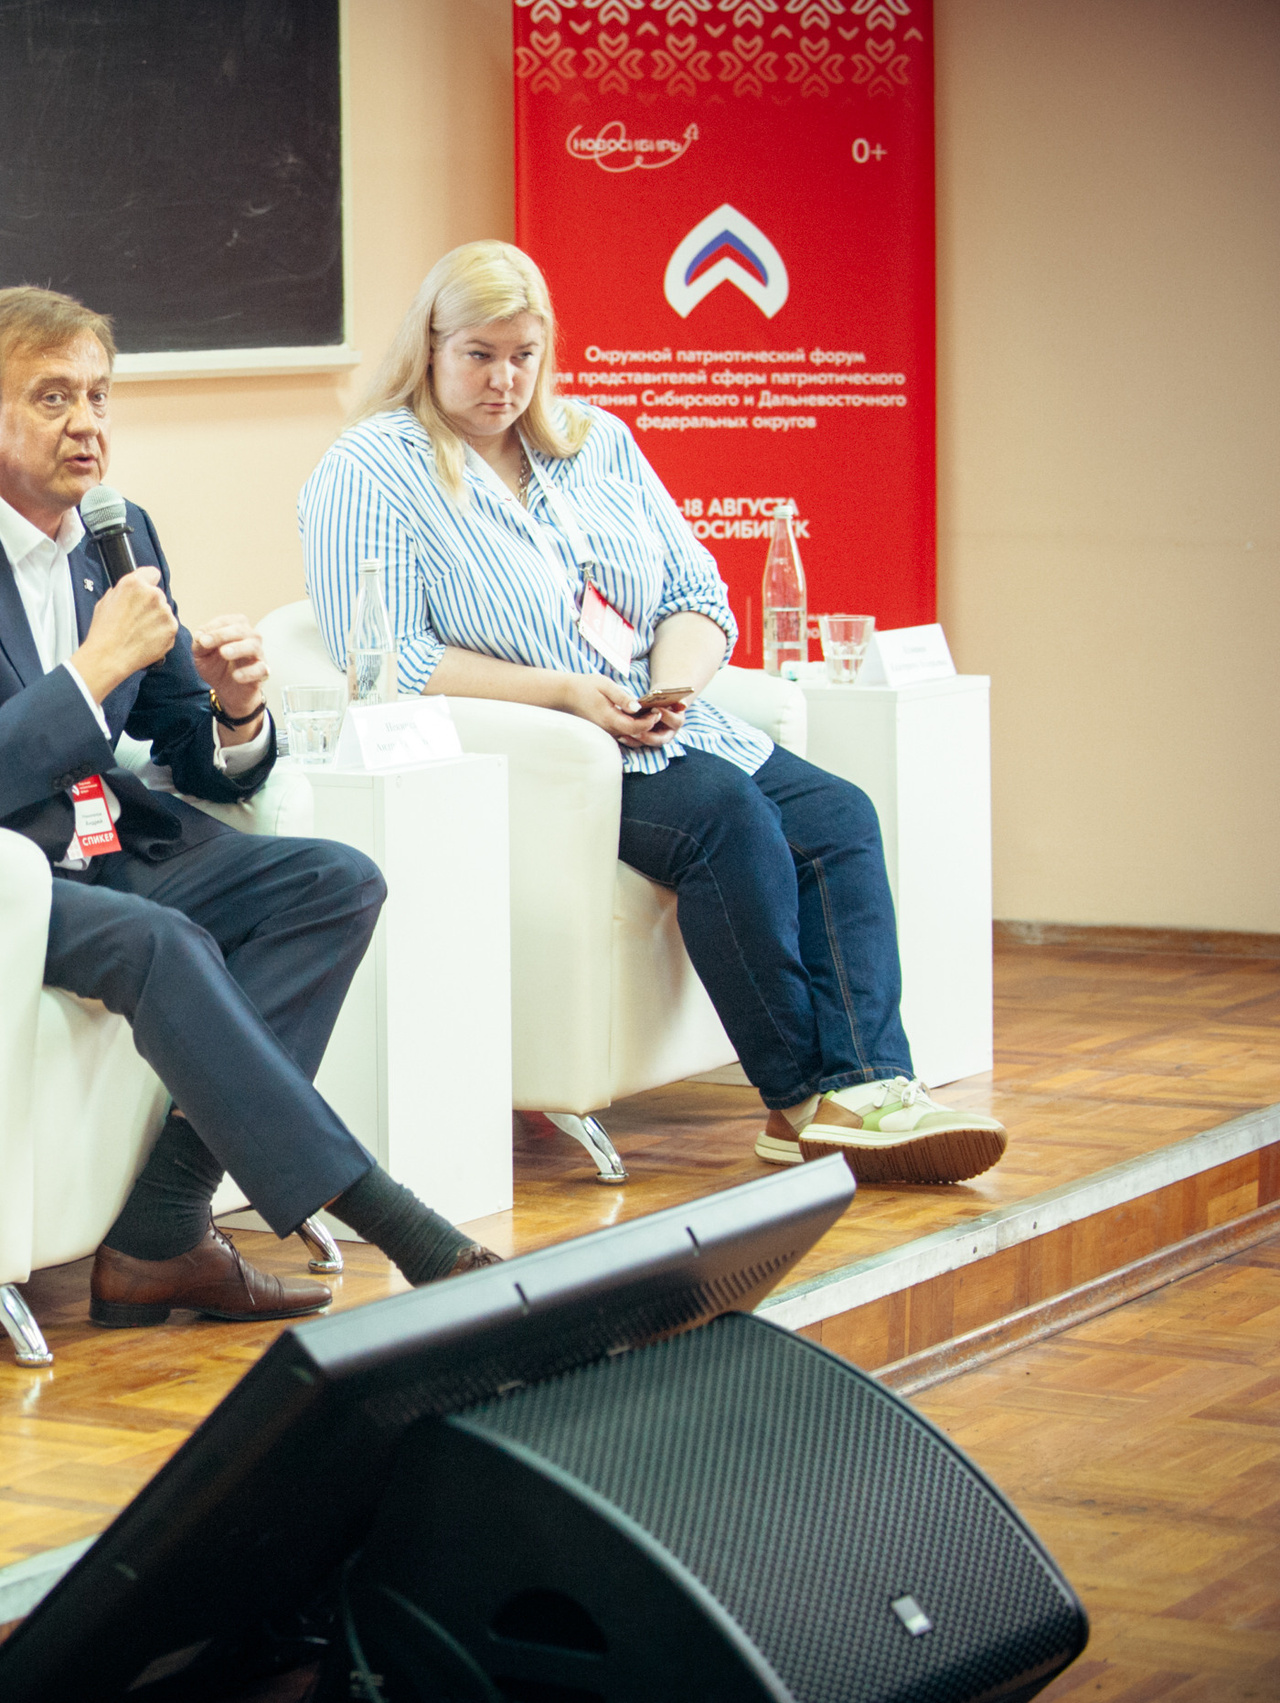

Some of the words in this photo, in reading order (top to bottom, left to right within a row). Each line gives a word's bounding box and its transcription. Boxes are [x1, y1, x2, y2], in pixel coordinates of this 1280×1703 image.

[852, 138, 888, 164] 0+
[584, 345, 672, 366] Окружной
[676, 347, 806, 366] патриотический
[809, 347, 866, 367] форум
[578, 369, 708, 387] представителей
[711, 369, 767, 388] сферы
[771, 372, 906, 388] патриотического
[641, 390, 740, 410] Сибирского
[743, 394, 754, 407] и
[758, 390, 907, 409] Дальневосточного
[636, 412, 748, 431] федеральных
[752, 416, 817, 432] округов
[82, 832, 115, 847] СПИКЕР
